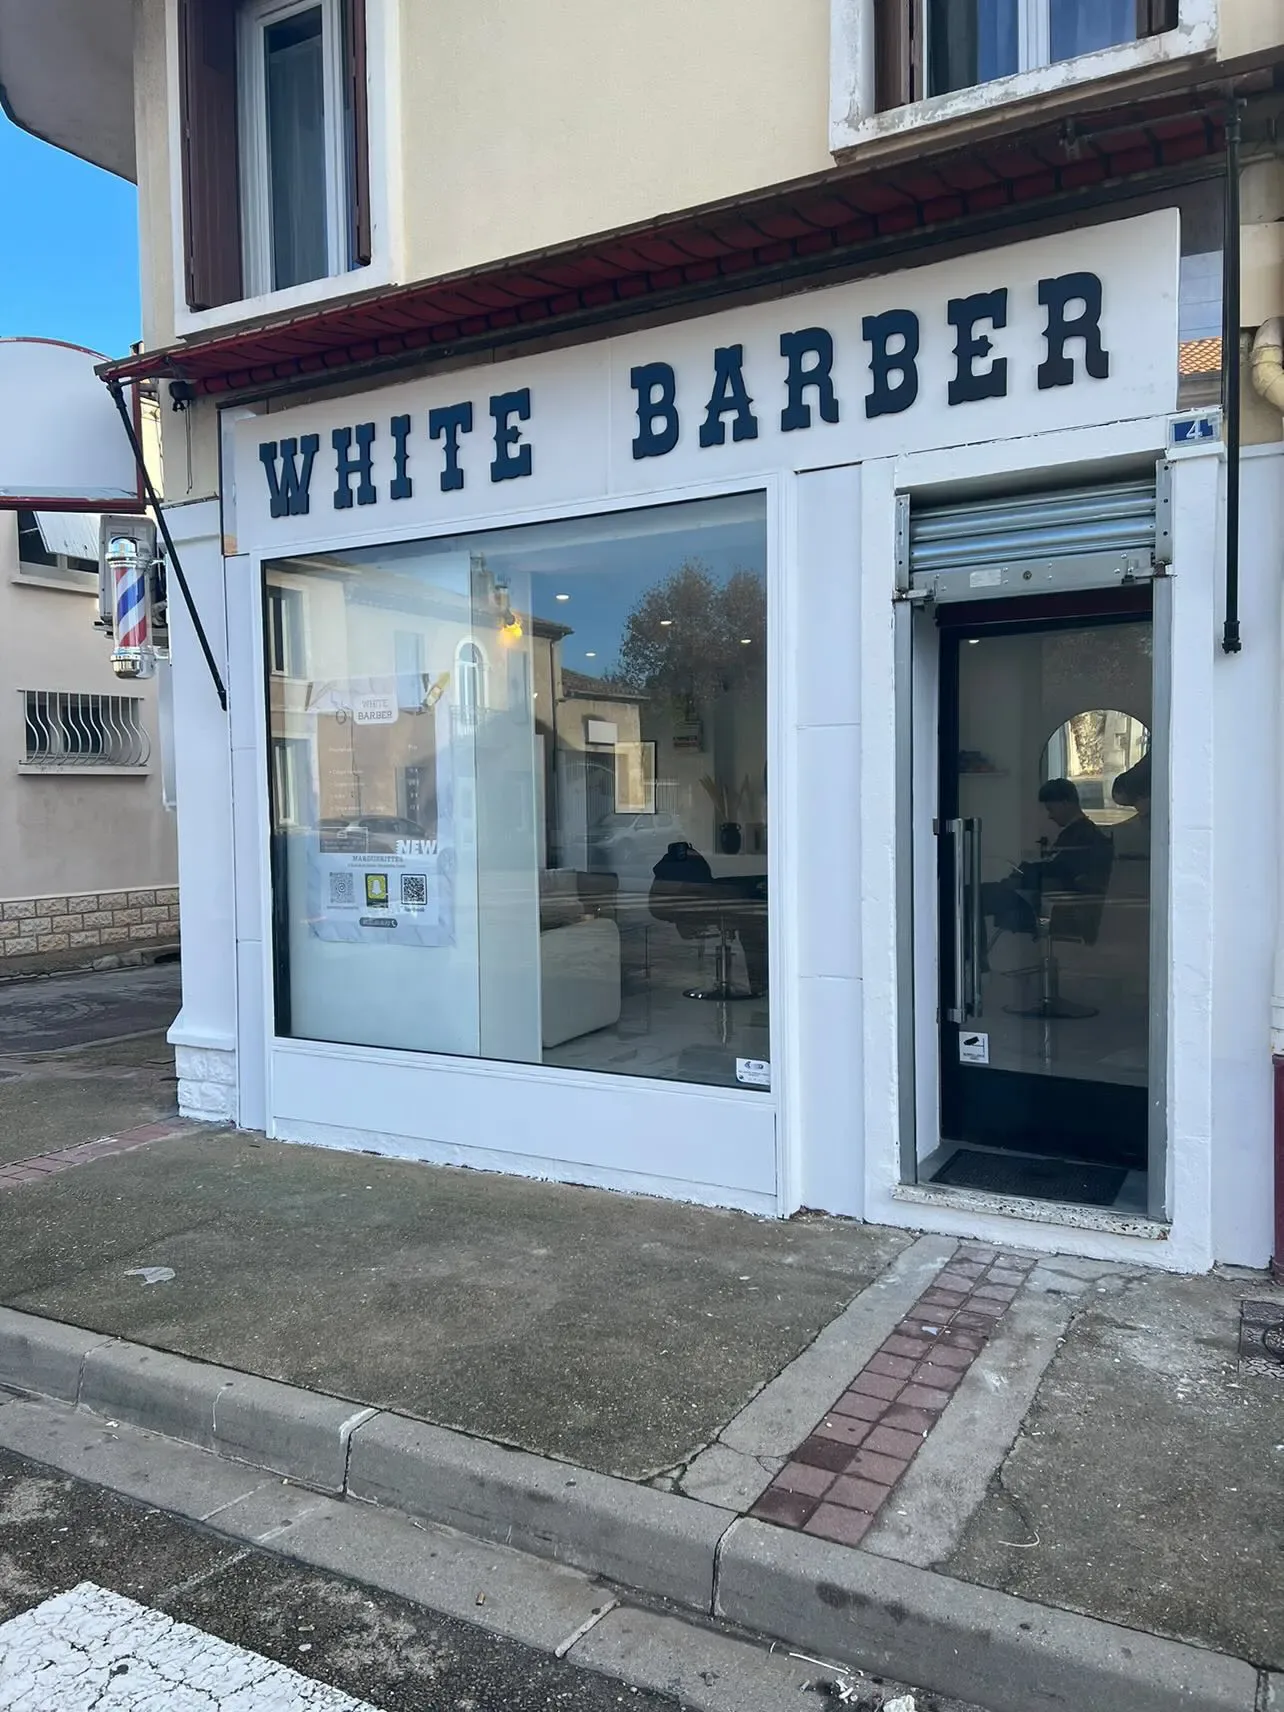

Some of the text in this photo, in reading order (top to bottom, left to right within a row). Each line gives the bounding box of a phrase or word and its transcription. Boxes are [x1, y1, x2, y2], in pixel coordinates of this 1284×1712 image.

[259, 272, 1109, 518] WHITE BARBER
[1186, 420, 1203, 440] 4
[357, 711, 393, 720] BARBER
[396, 839, 438, 855] NEW
